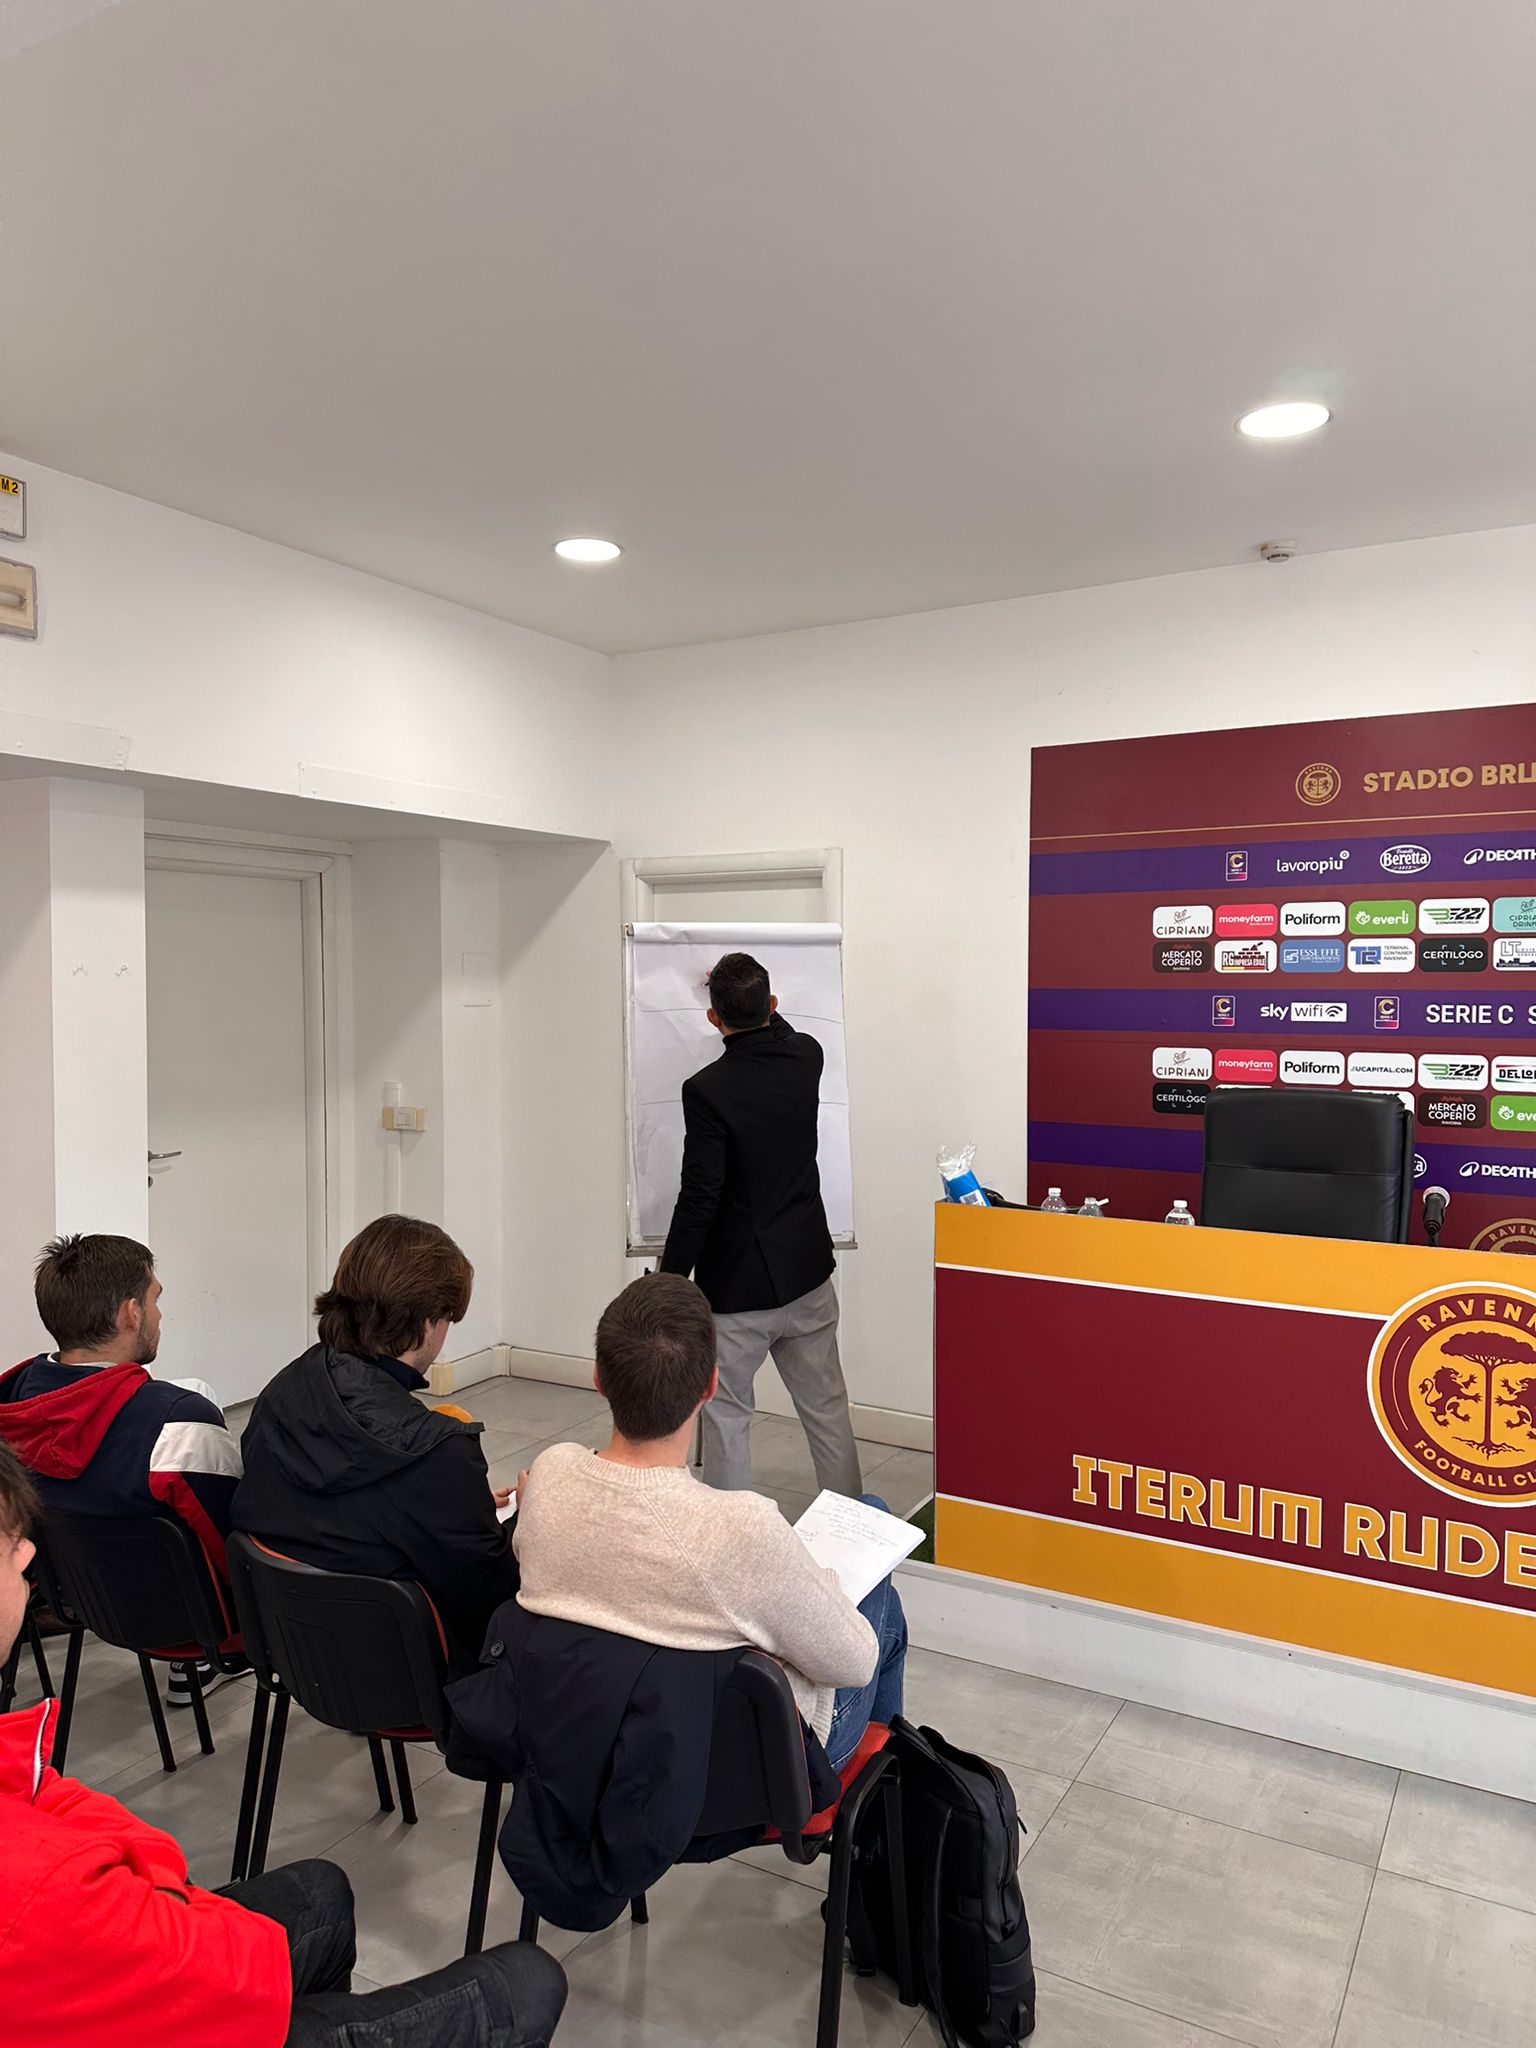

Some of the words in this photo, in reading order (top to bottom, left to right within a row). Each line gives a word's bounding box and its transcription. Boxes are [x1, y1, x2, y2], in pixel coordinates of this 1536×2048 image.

[12, 482, 18, 494] 2
[1363, 766, 1474, 793] STADIO
[1383, 852, 1428, 867] Beretta
[1219, 914, 1274, 924] moneyfarm
[1285, 913, 1341, 926] Poliform
[1372, 910, 1410, 925] everli
[1156, 925, 1210, 935] CIPRIANI
[1162, 950, 1203, 959] MERCATO
[1300, 948, 1319, 957] ESSE
[1423, 950, 1484, 960] CERTILOGO
[1162, 958, 1203, 967] COPERTO
[1222, 952, 1234, 966] RG
[1260, 1003, 1289, 1020] sky
[1294, 1004, 1323, 1018] wifi
[1425, 1004, 1493, 1024] SERIE
[1497, 1004, 1514, 1025] C
[1218, 1059, 1273, 1069] moneyfarm
[1284, 1061, 1340, 1075] Poliform
[1156, 1066, 1209, 1077] CIPRIANI
[1499, 1069, 1536, 1080] DELLO
[1428, 1102, 1476, 1112] MERCATO
[1428, 1110, 1476, 1121] COPERTO
[1414, 1439, 1507, 1488] FOOTBALL
[1072, 1453, 1323, 1549] ITERUM
